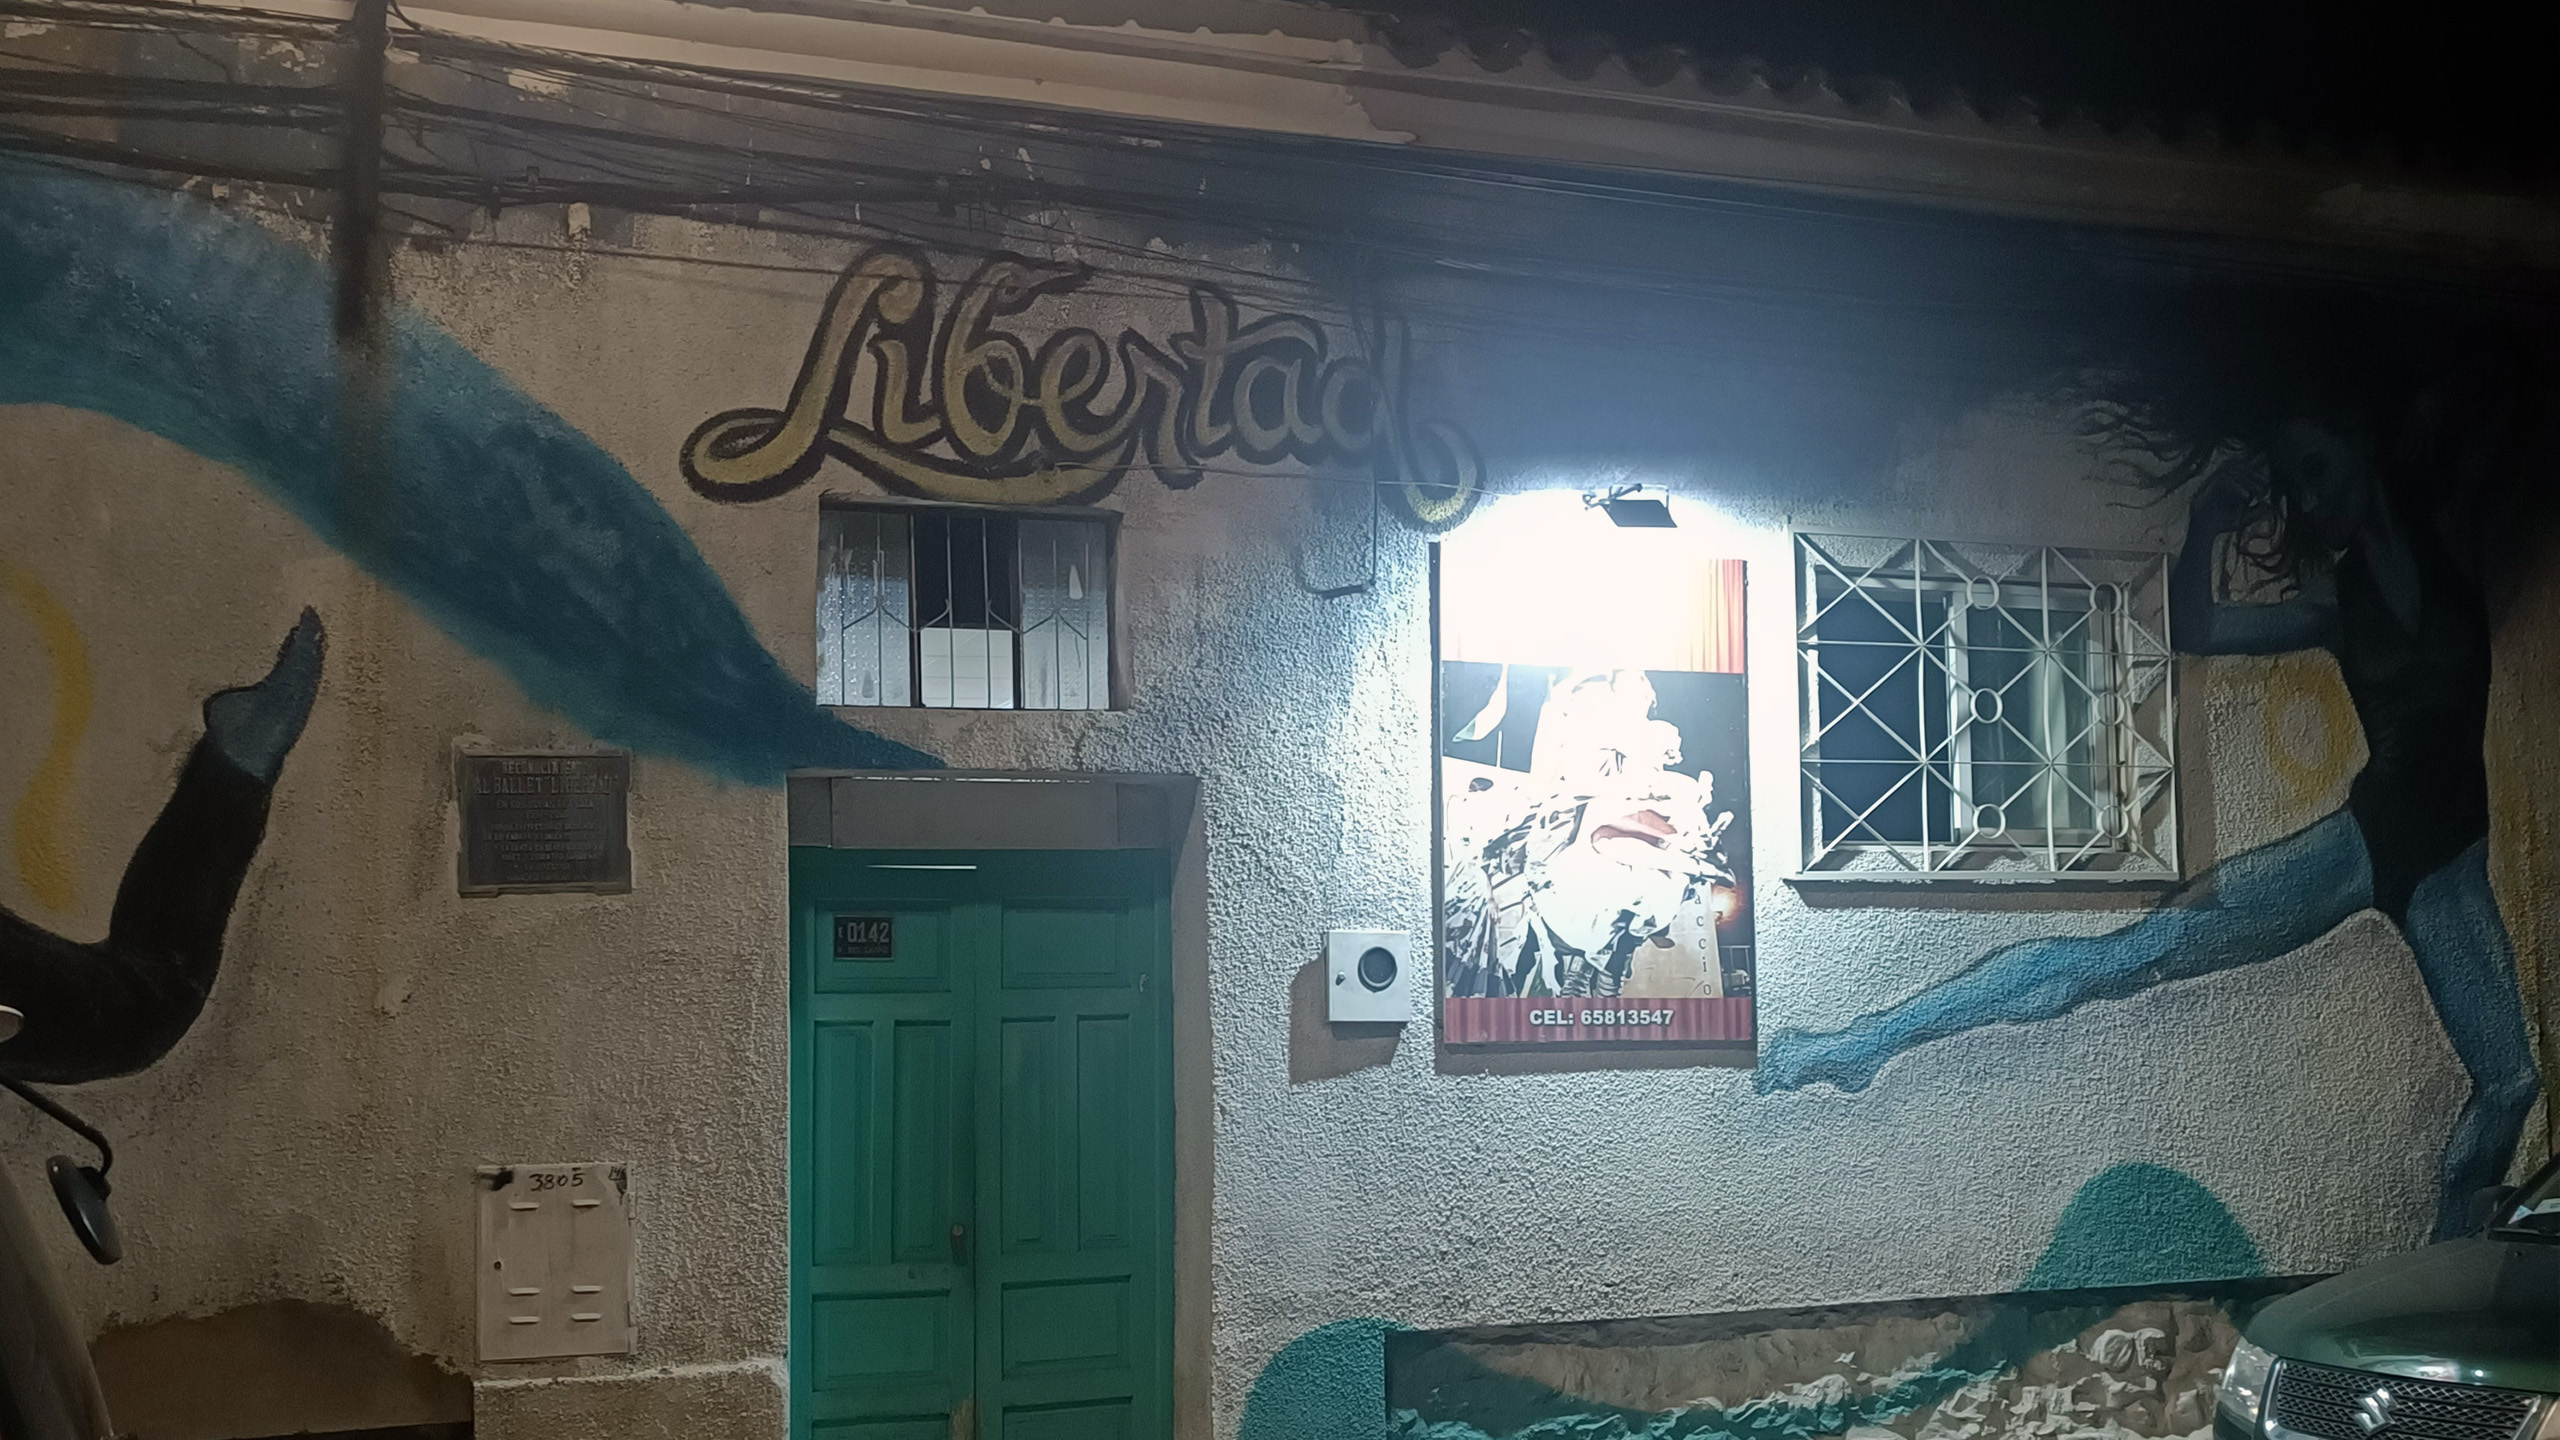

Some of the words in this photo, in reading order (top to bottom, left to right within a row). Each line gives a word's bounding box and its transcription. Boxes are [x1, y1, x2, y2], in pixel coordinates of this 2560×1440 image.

[679, 244, 1486, 531] Libertad
[494, 776, 543, 795] BALLET
[847, 921, 890, 943] 0142
[1529, 1009, 1575, 1026] CEL:
[1580, 1009, 1675, 1026] 65813547
[529, 1171, 587, 1192] 3805
